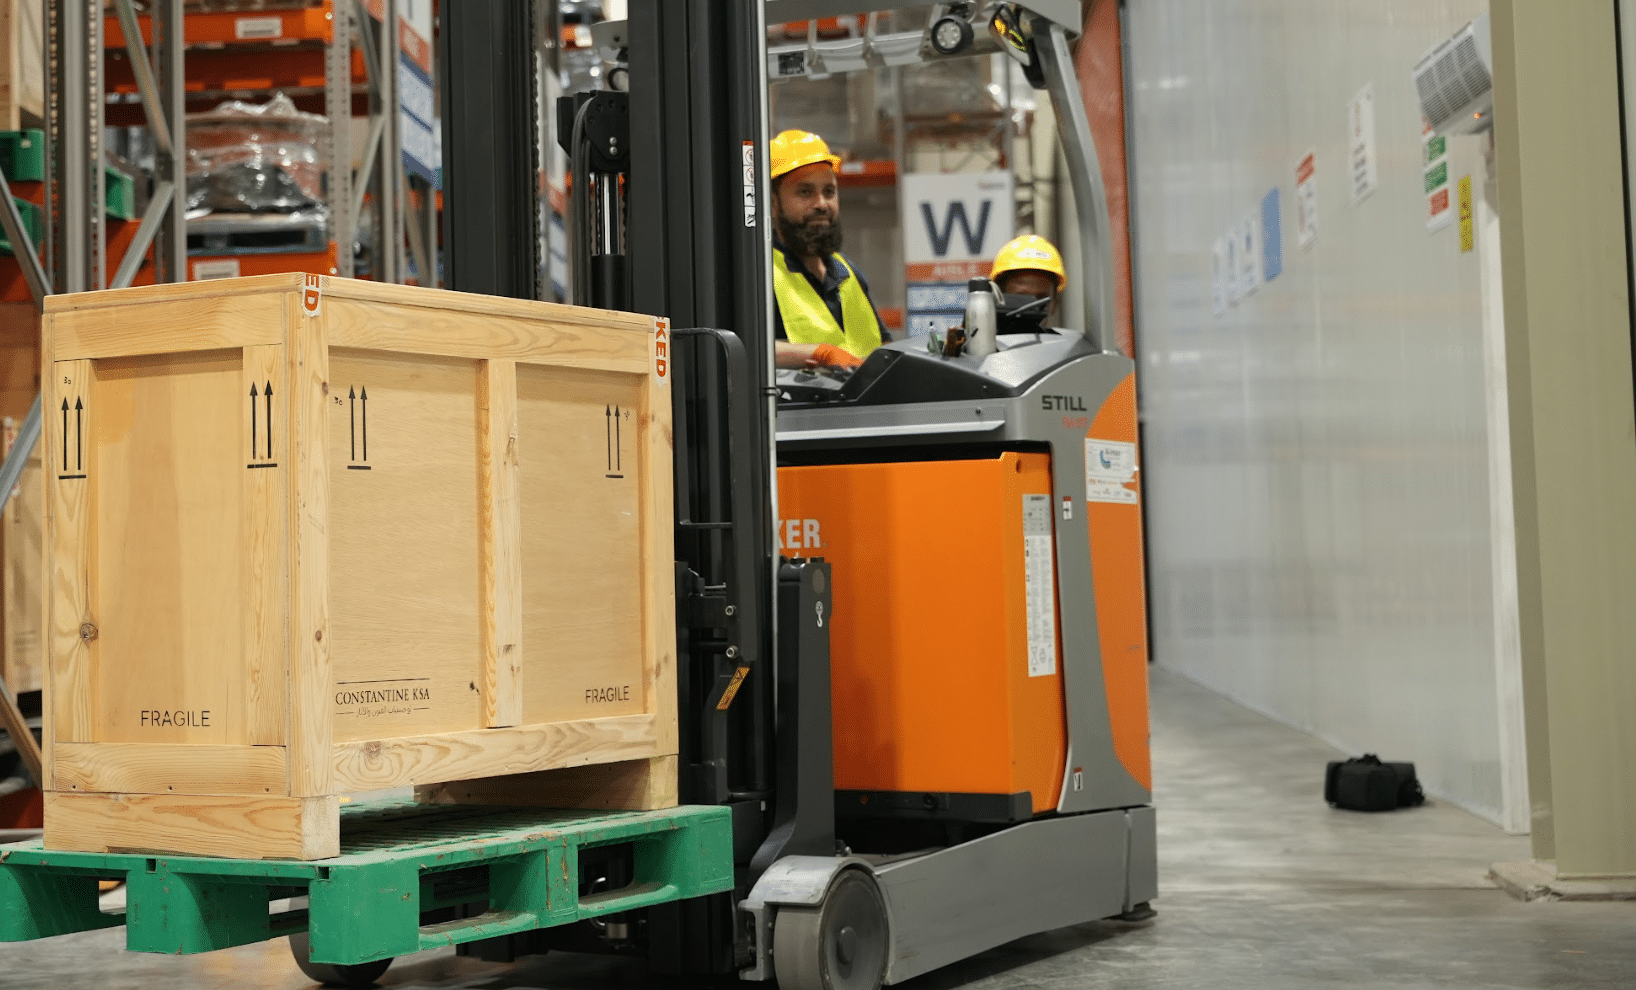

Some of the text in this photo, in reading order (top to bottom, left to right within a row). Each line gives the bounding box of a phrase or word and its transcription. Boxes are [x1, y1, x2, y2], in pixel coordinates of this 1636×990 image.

[920, 201, 991, 256] W
[656, 316, 667, 377] KED
[1042, 394, 1087, 412] STILL
[335, 688, 430, 705] CONSTANTINE KSA
[585, 685, 630, 704] FRAGILE
[141, 710, 210, 727] FRAGILE
